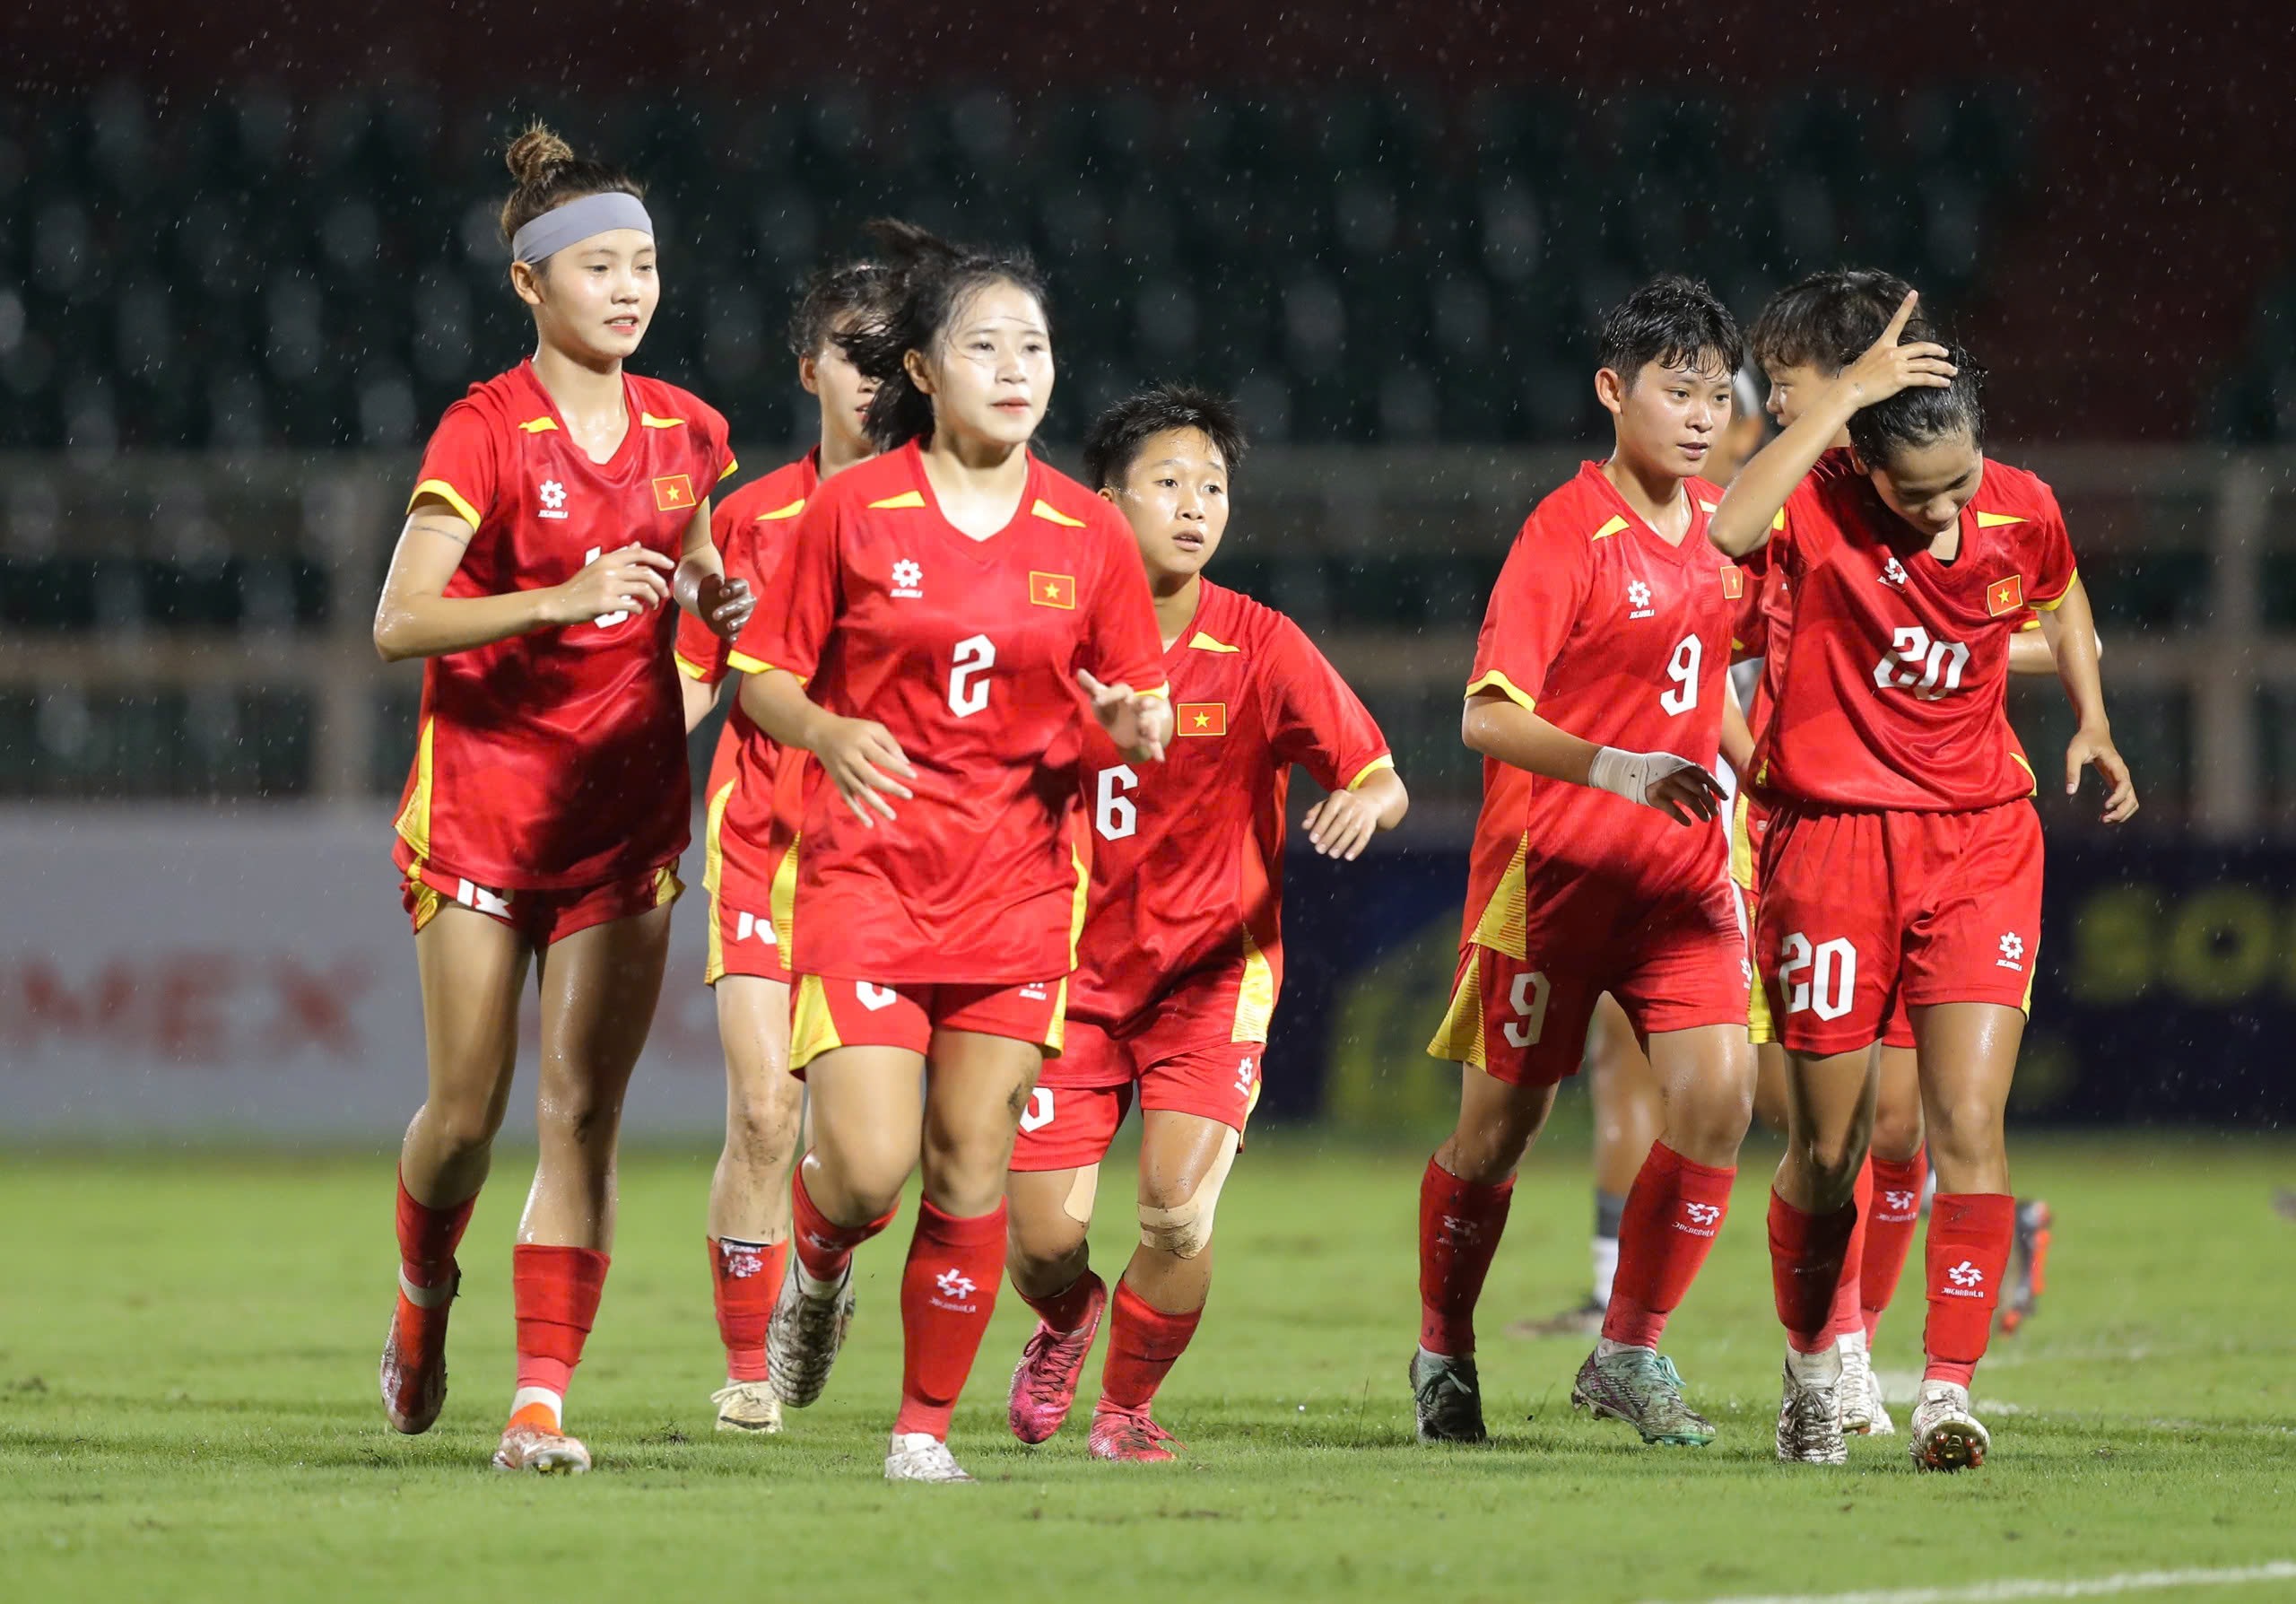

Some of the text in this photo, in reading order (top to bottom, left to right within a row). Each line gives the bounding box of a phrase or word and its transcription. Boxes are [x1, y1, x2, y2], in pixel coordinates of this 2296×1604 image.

[948, 633, 996, 718] 2
[1660, 633, 1702, 717] 9
[1873, 626, 1970, 701] 20
[1096, 763, 1138, 841] 6
[1502, 971, 1552, 1048] 9
[1779, 932, 1857, 1021] 20
